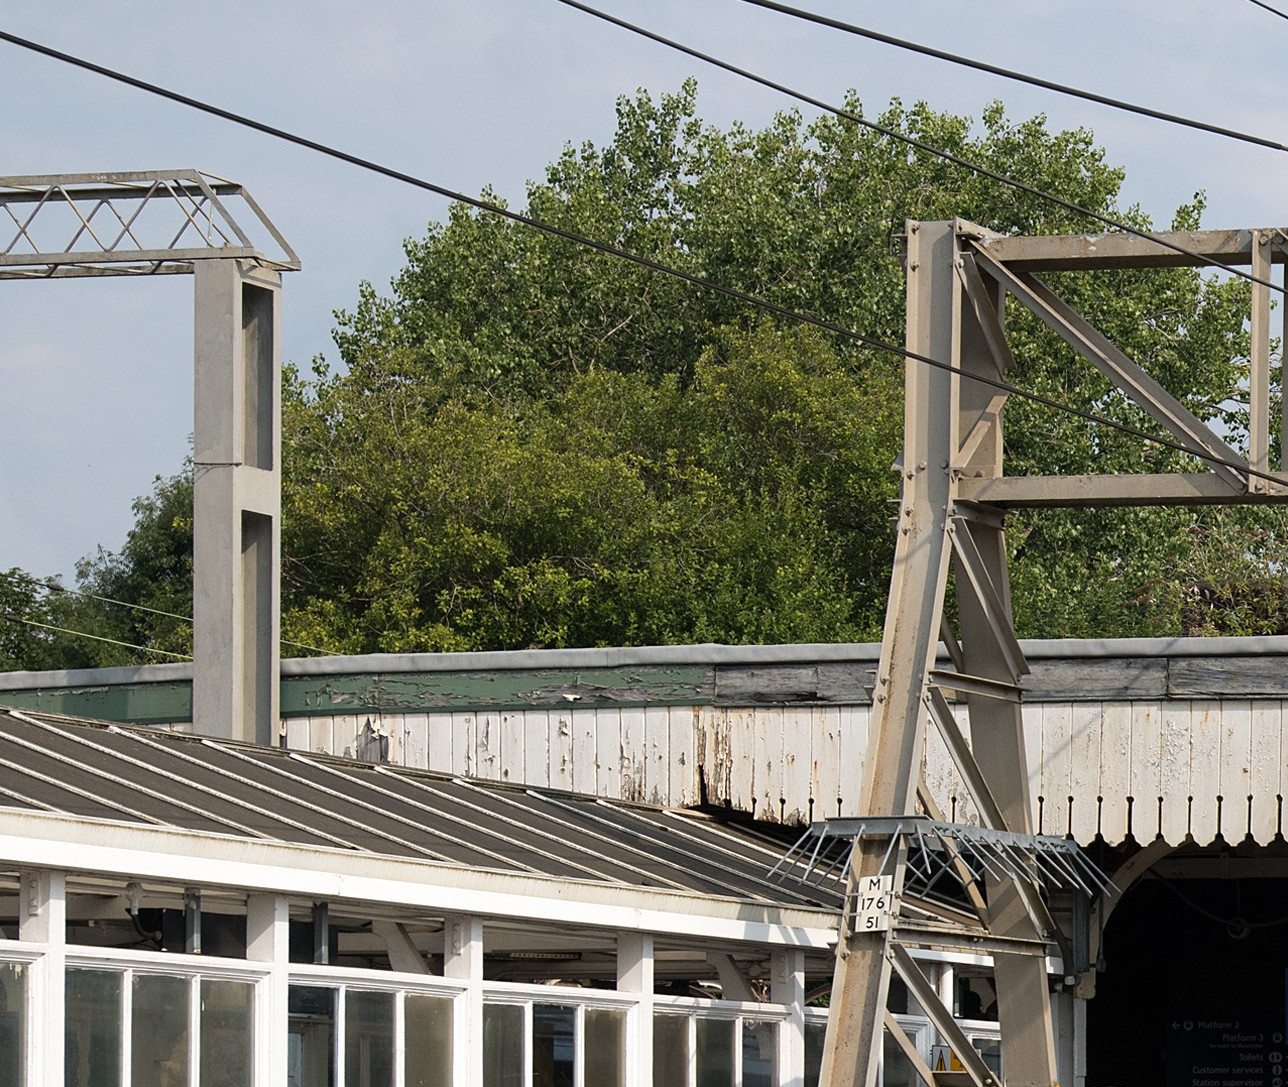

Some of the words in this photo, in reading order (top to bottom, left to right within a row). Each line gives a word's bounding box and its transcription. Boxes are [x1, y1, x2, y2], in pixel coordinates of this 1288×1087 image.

[869, 878, 881, 891] M
[861, 897, 885, 911] 176
[866, 916, 879, 929] 51
[1198, 1021, 1232, 1029] Platform
[1233, 1021, 1240, 1029] 2
[1222, 1033, 1256, 1042] Platform
[1257, 1033, 1264, 1042] 3
[1239, 1052, 1264, 1062] Toilets
[1192, 1065, 1230, 1074] Customer
[1231, 1066, 1264, 1074] services
[1192, 1078, 1220, 1087] Station
